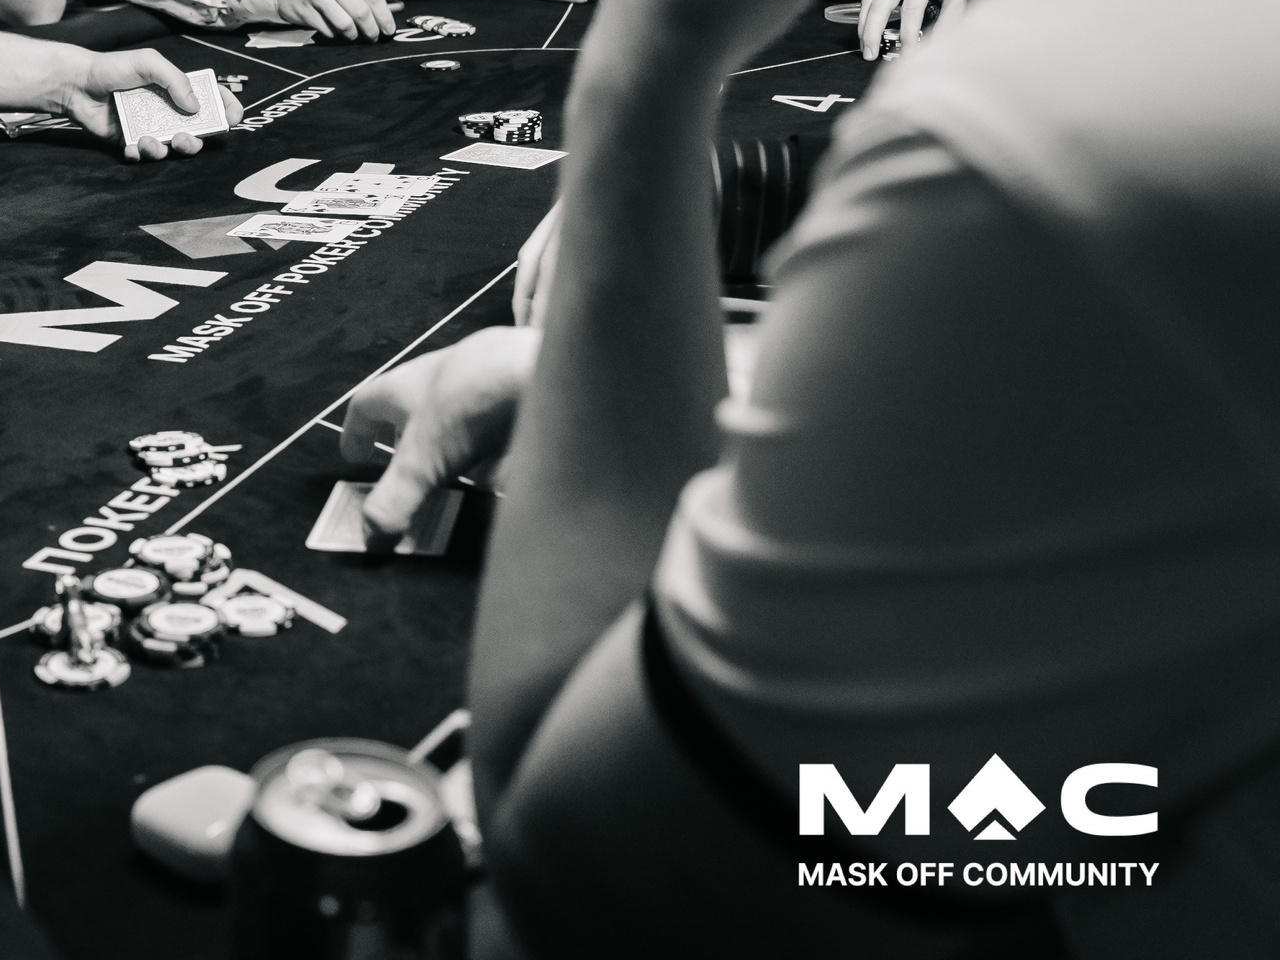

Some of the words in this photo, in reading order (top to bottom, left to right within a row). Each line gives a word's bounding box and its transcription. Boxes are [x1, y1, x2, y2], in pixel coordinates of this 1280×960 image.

[229, 86, 336, 132] ПОКЕРОК
[772, 94, 856, 113] 4
[147, 313, 254, 363] MASK
[230, 283, 294, 313] OFF
[273, 239, 368, 284] POKER
